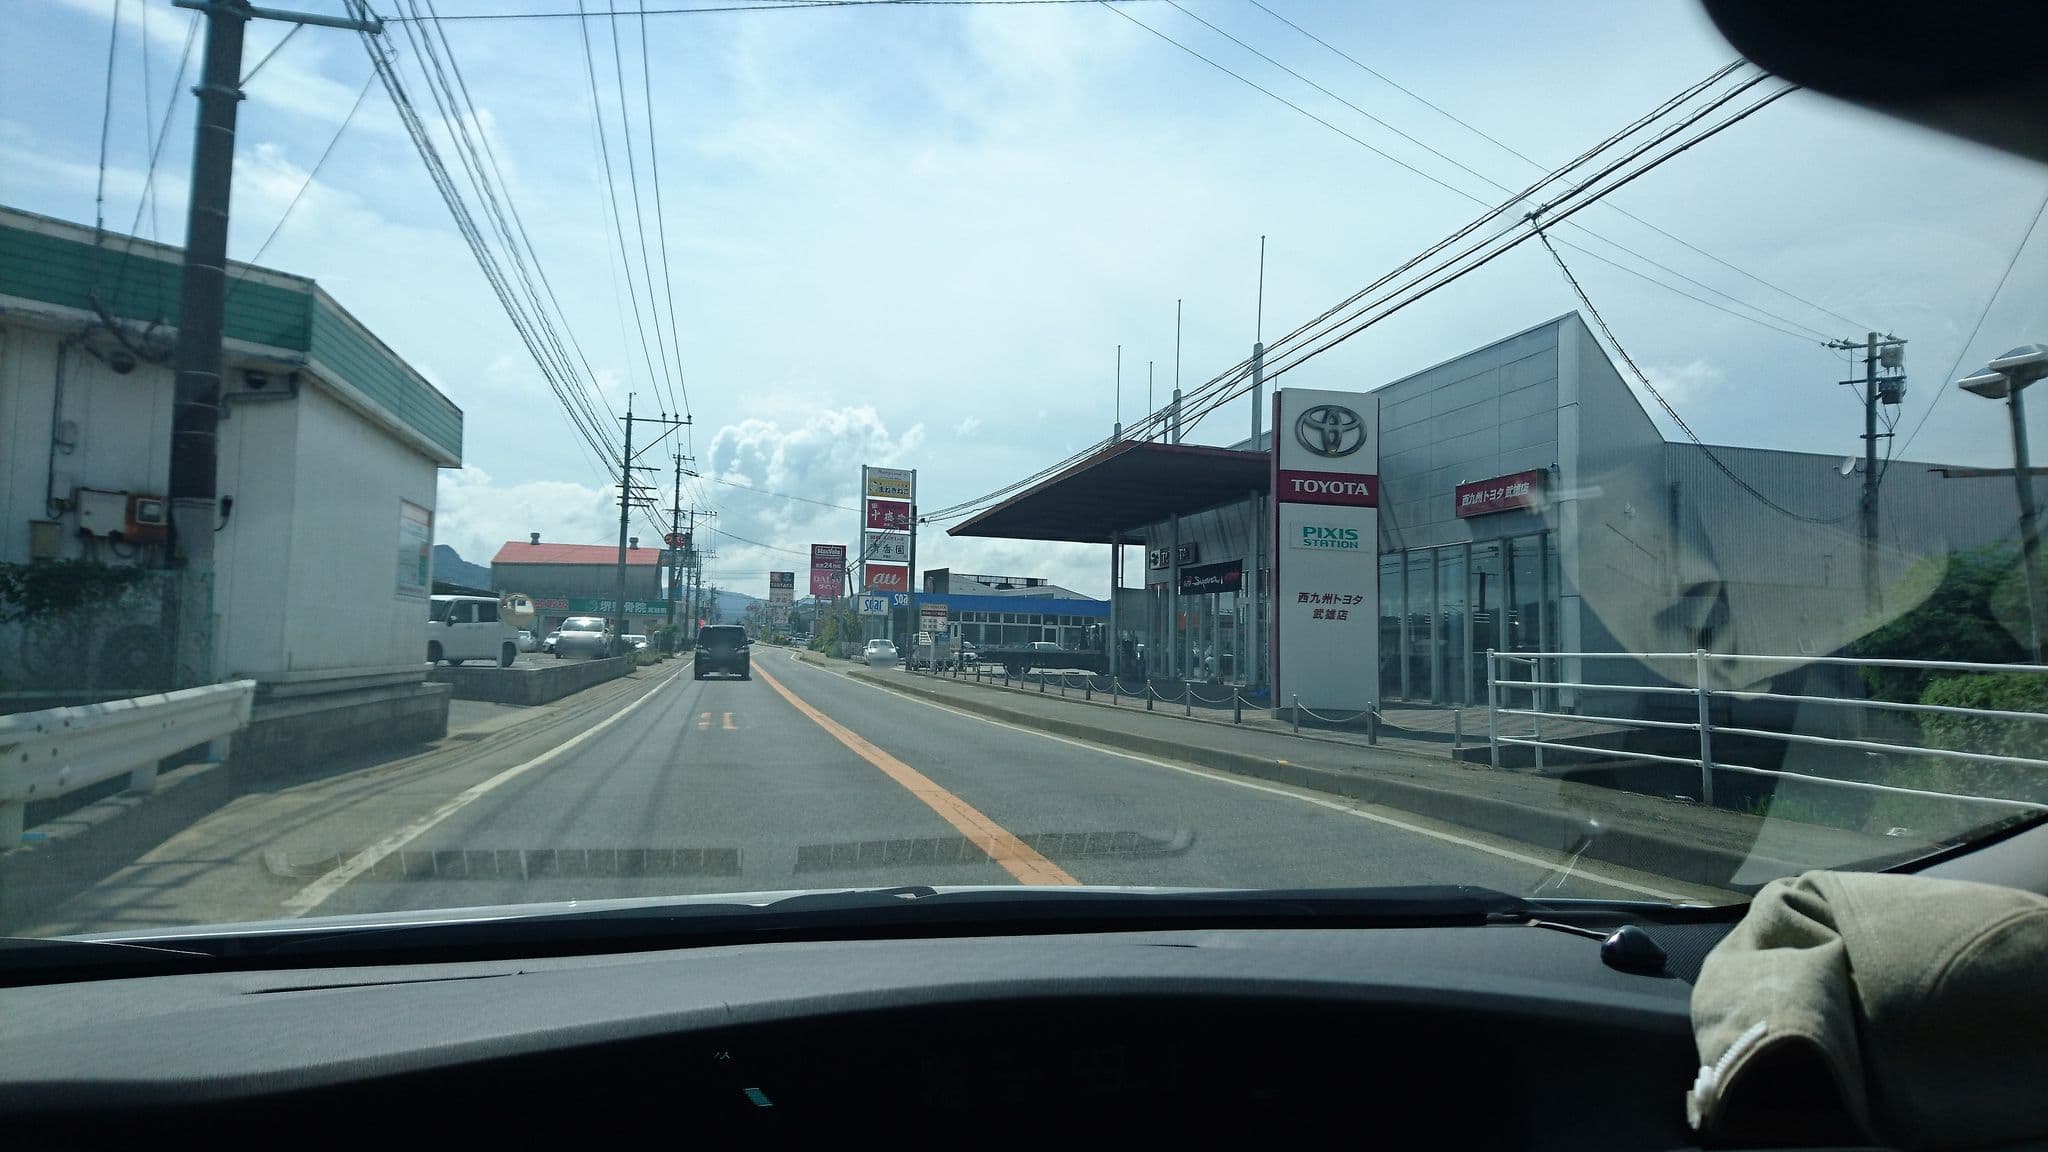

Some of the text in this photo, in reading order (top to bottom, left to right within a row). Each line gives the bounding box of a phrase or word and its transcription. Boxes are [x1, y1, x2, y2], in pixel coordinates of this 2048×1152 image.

[1291, 479, 1369, 496] TOYOTA
[1461, 482, 1529, 506] 西九州トヨタ 武雄店
[1303, 526, 1358, 540] PIXIS
[1303, 539, 1358, 548] STATION
[872, 572, 901, 585] au
[1297, 592, 1363, 605] 西九州トヨタ
[1312, 608, 1349, 621] 武雄店
